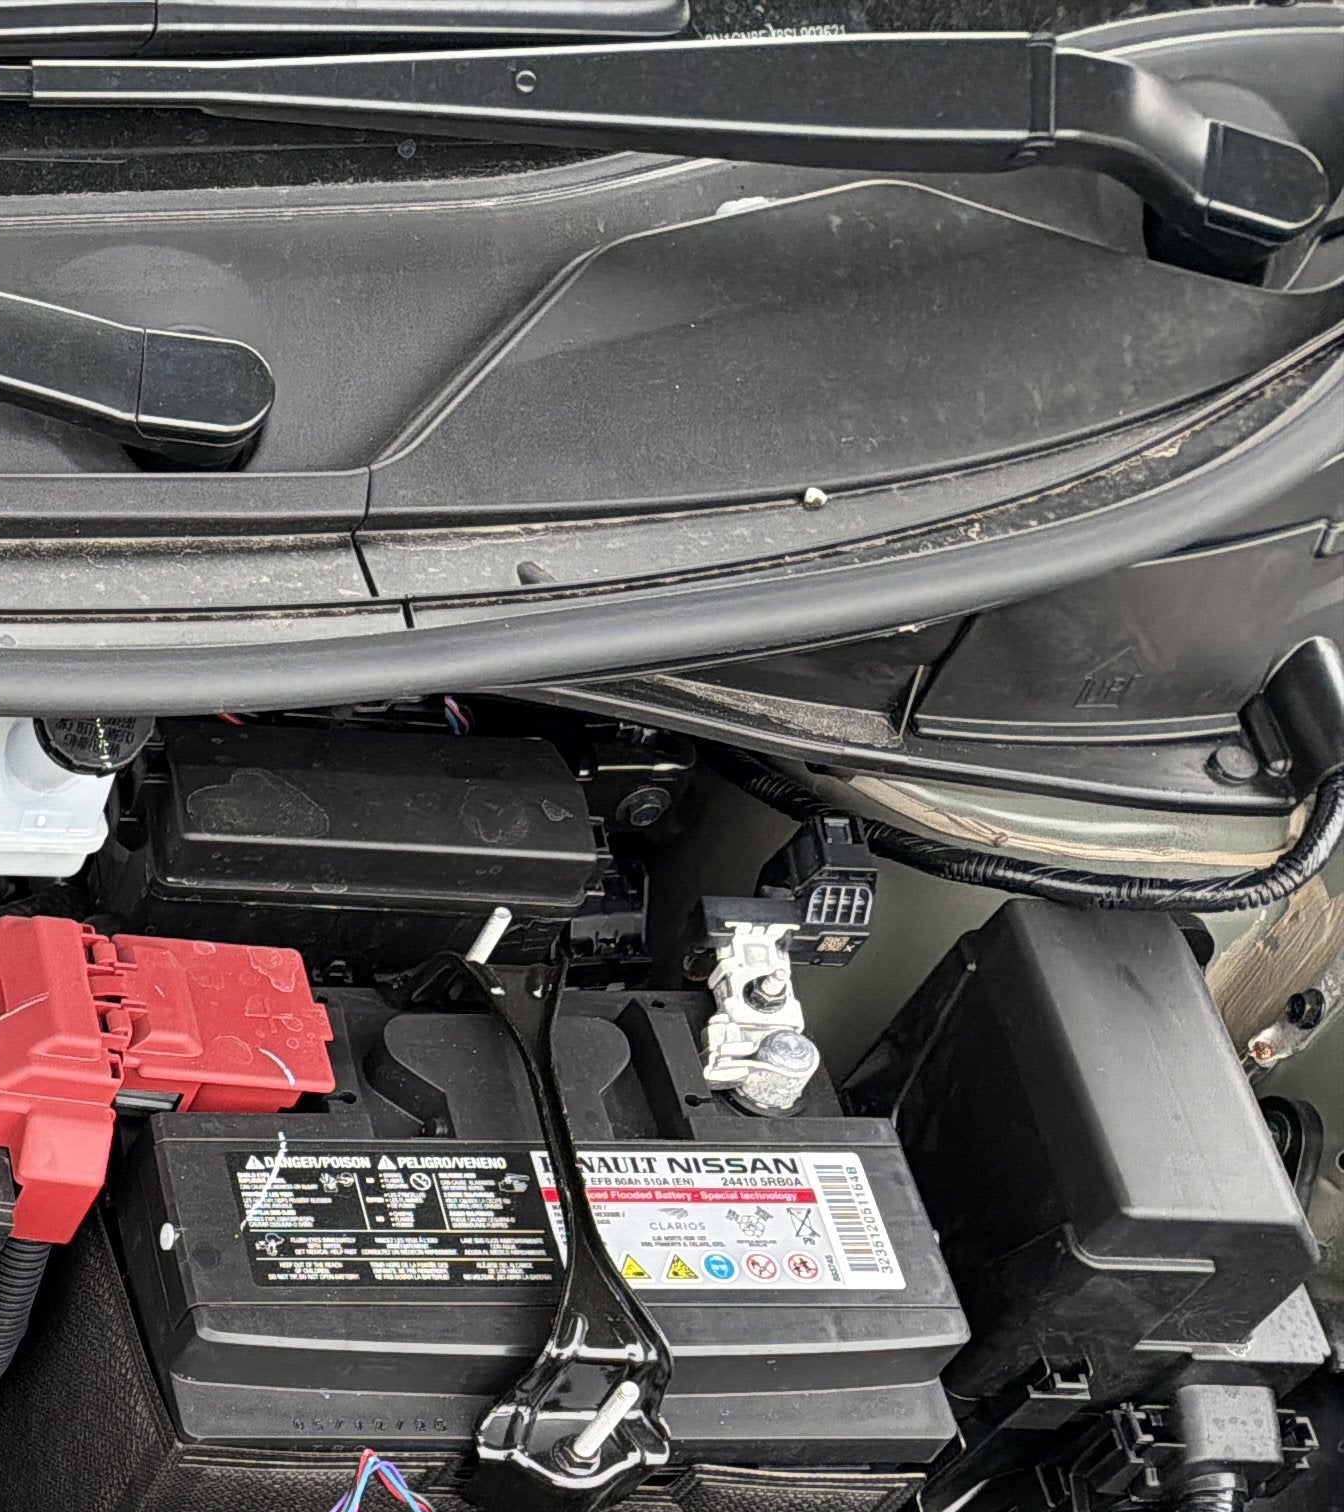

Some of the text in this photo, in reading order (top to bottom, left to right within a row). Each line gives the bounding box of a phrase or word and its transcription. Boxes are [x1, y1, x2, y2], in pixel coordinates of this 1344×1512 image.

[396, 1156, 507, 1170] PELIGRO/VENENO
[666, 1156, 801, 1175] NISSAN
[591, 1177, 696, 1188] EFB 60Ah 510A (EN)
[721, 1177, 758, 1188] 24410
[610, 1189, 653, 1202] Flooded
[654, 1189, 692, 1203] Battery
[700, 1189, 739, 1203] Special
[739, 1190, 798, 1204] technology
[648, 1221, 707, 1233] CLARIOS
